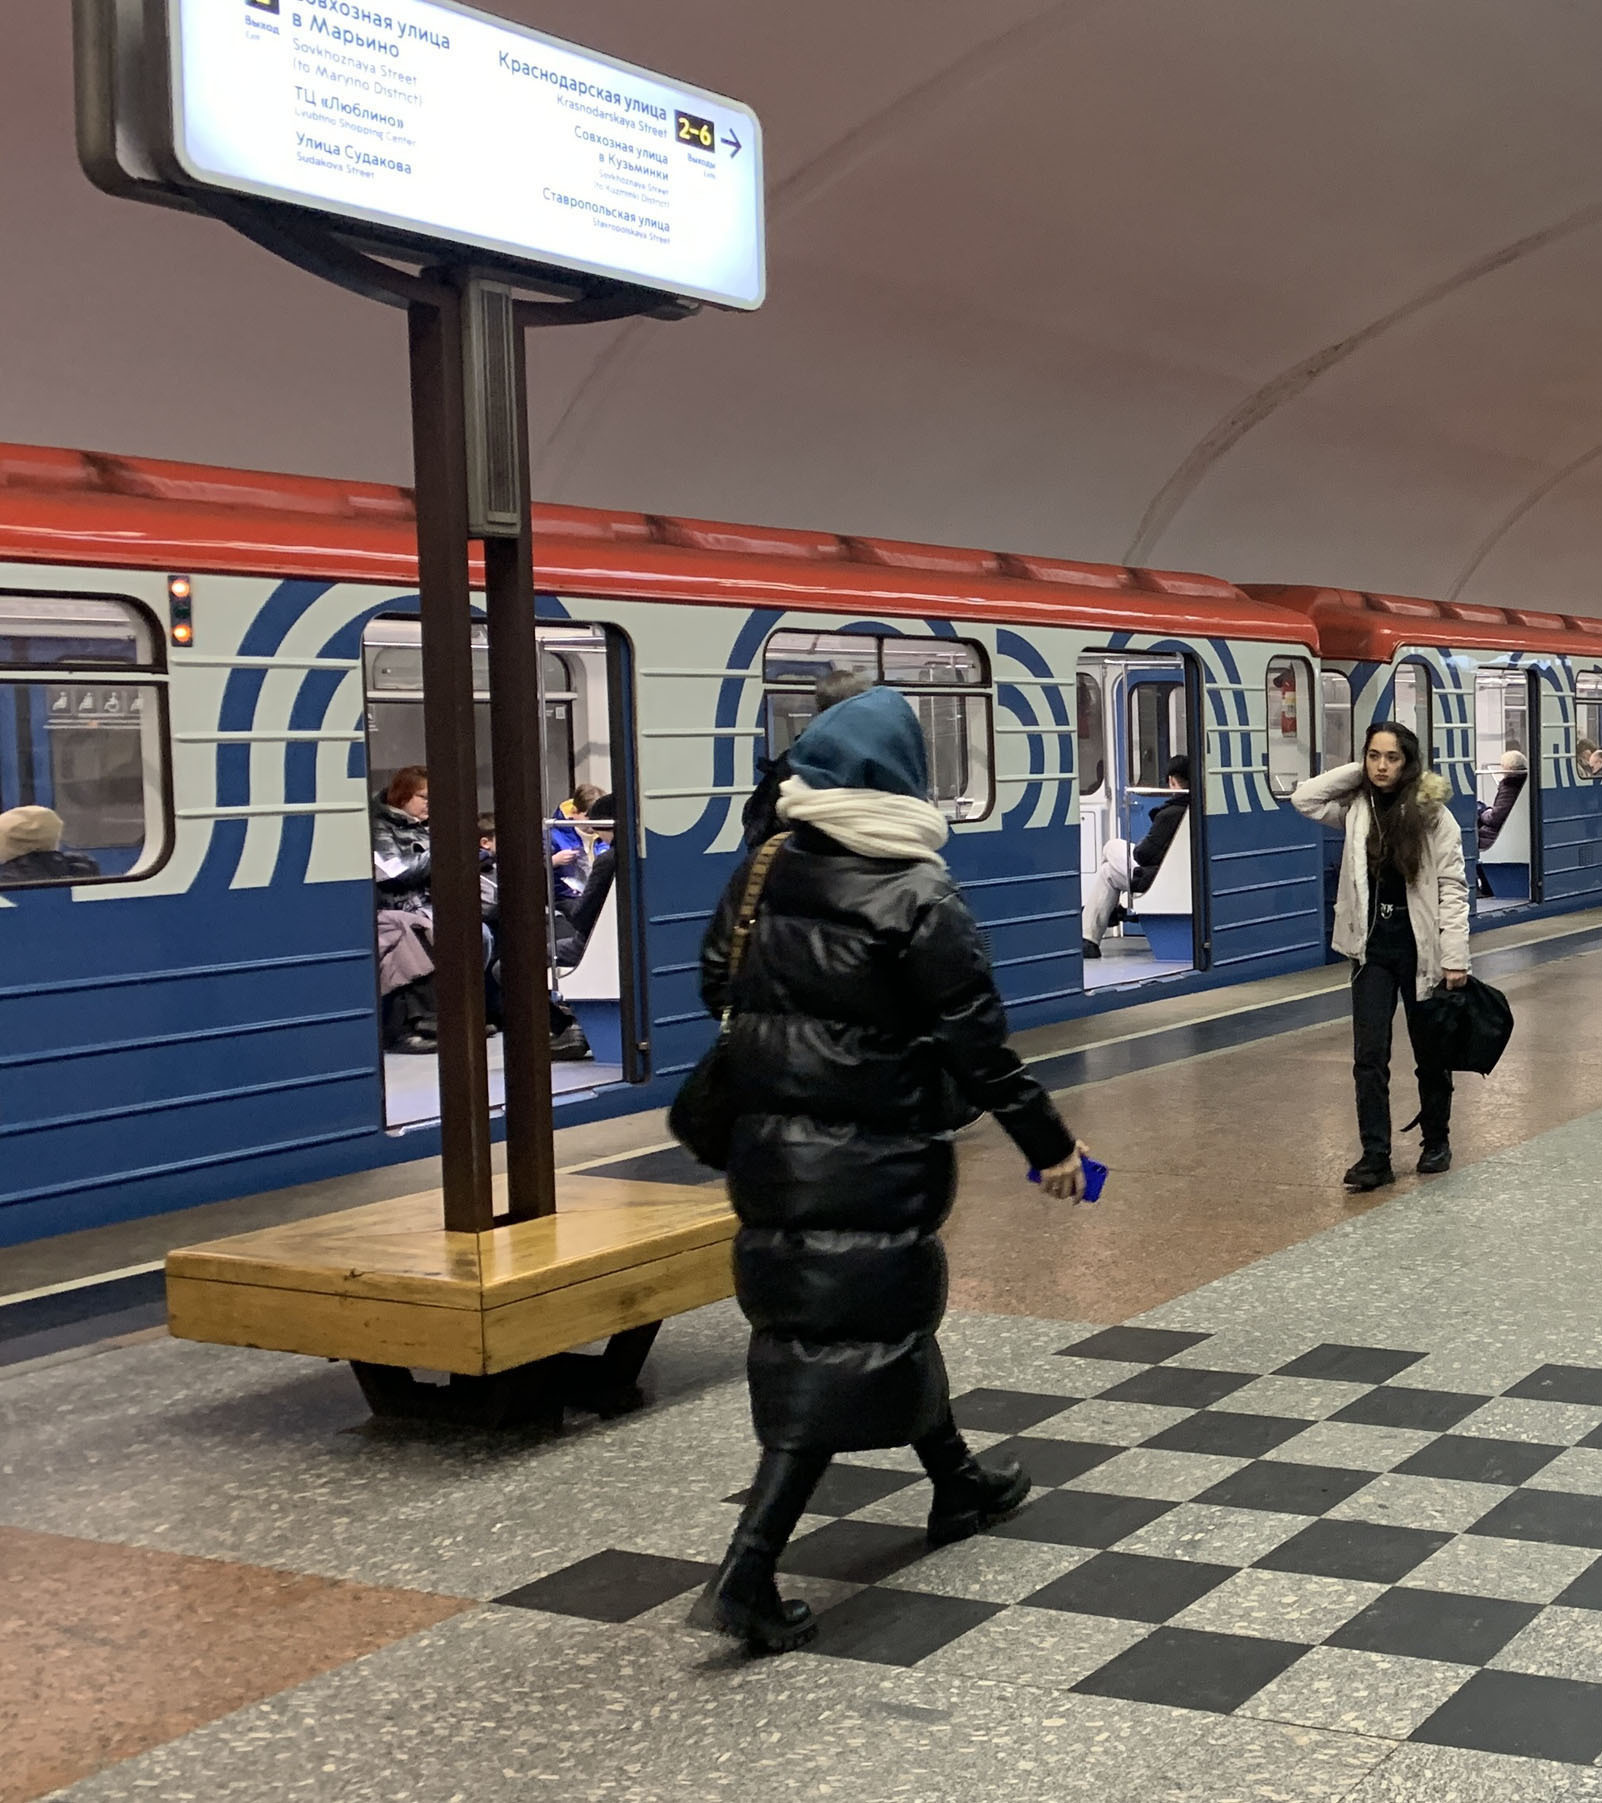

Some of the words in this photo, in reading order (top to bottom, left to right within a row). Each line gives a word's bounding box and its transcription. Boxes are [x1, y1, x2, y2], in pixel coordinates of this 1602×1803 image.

[292, 13, 302, 27] в
[309, 14, 400, 58] Марьино
[297, 0, 392, 31] вхозная
[397, 20, 451, 50] улица
[292, 37, 377, 75] Sovkhoznaya
[380, 64, 418, 86] Street
[315, 64, 370, 91] Maryino
[294, 85, 317, 107] ТЦ
[320, 95, 405, 129] «Люблино»
[497, 50, 621, 107] Краснодарская
[624, 95, 668, 122] улица
[556, 95, 637, 132] Krasnodarskaya
[638, 120, 668, 139] Street
[295, 130, 341, 156] Улица
[344, 144, 412, 175] Судакова
[574, 124, 634, 155] Совхозная
[636, 145, 669, 166] улица
[598, 152, 605, 163] в
[608, 153, 670, 182] Кузьминки
[346, 164, 375, 180] Street
[542, 186, 637, 222] Ставропольская
[638, 213, 671, 233] улица
